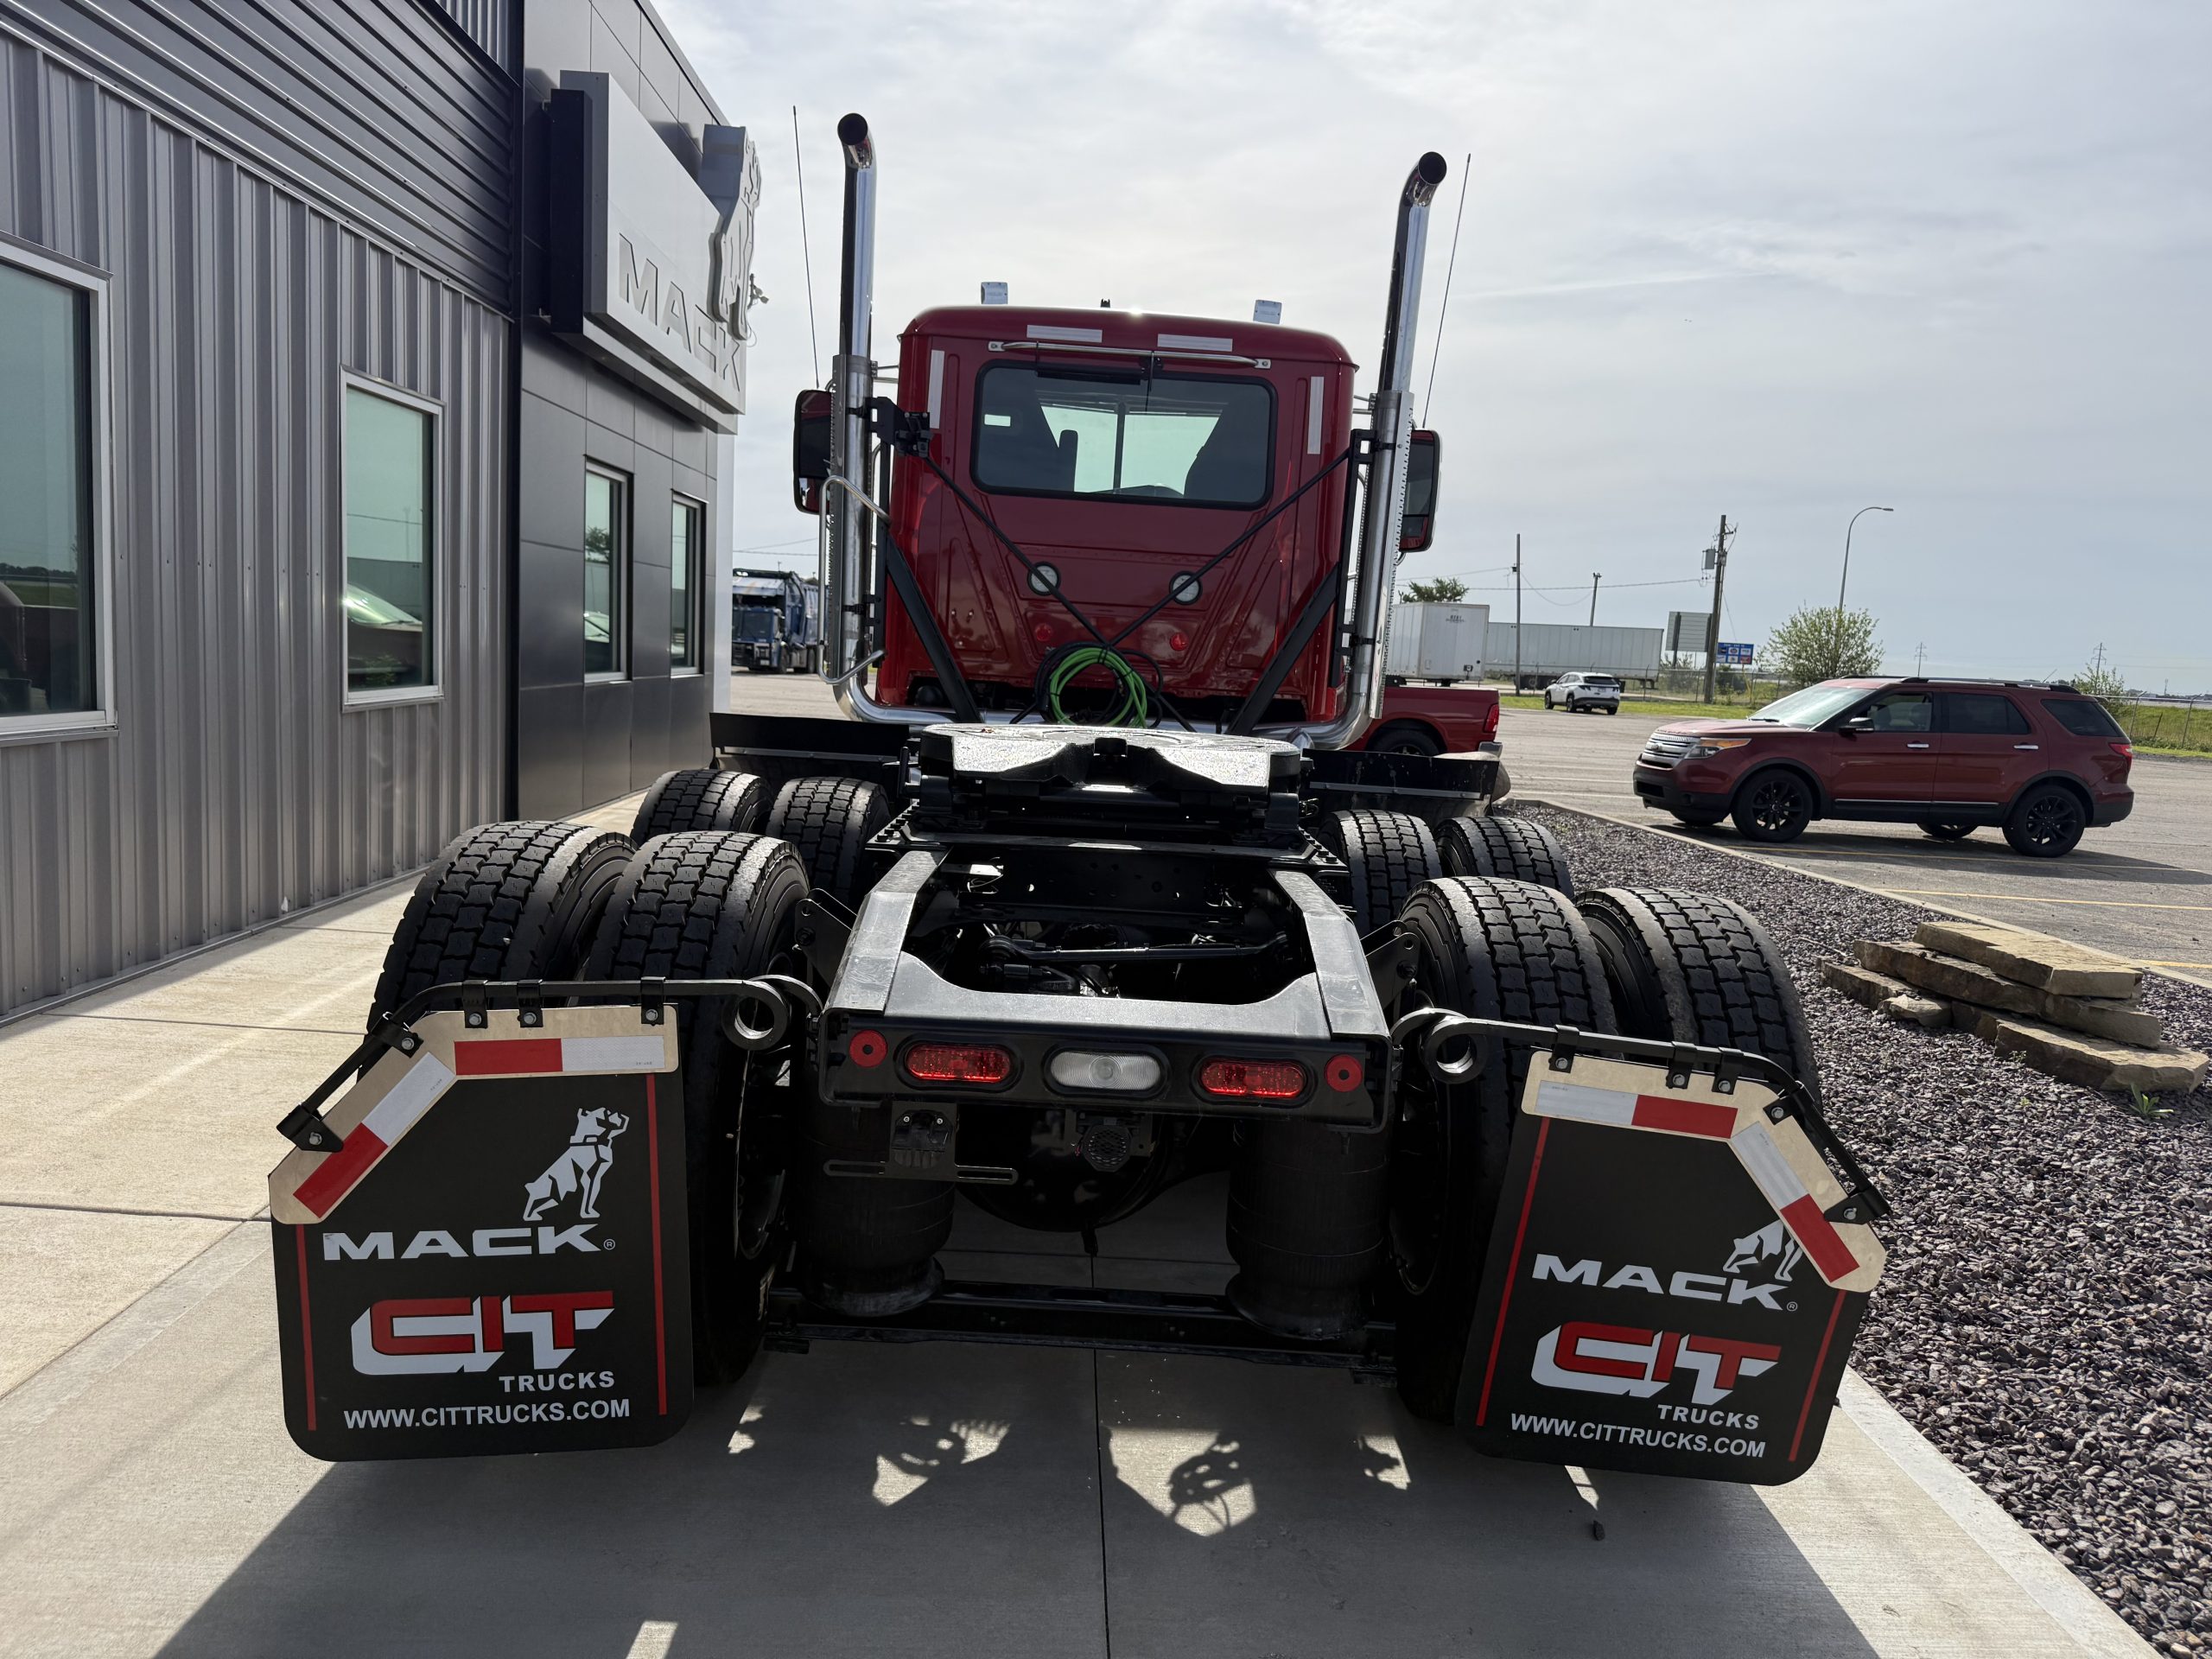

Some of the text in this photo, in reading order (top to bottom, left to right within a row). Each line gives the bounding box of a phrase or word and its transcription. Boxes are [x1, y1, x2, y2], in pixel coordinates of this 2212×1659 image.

[619, 232, 741, 392] MACK
[322, 1224, 601, 1261] MACK
[1532, 1253, 1789, 1311] MACK
[350, 1291, 614, 1376] CIT
[499, 1370, 614, 1393] TRUCKS
[1530, 1322, 1782, 1406] CIT
[343, 1398, 630, 1429] WWW.CITTRUCKS.COM
[1510, 1413, 1766, 1458] WWW.CITTRUCKS.COM
[1657, 1404, 1759, 1430] TRUCKS
